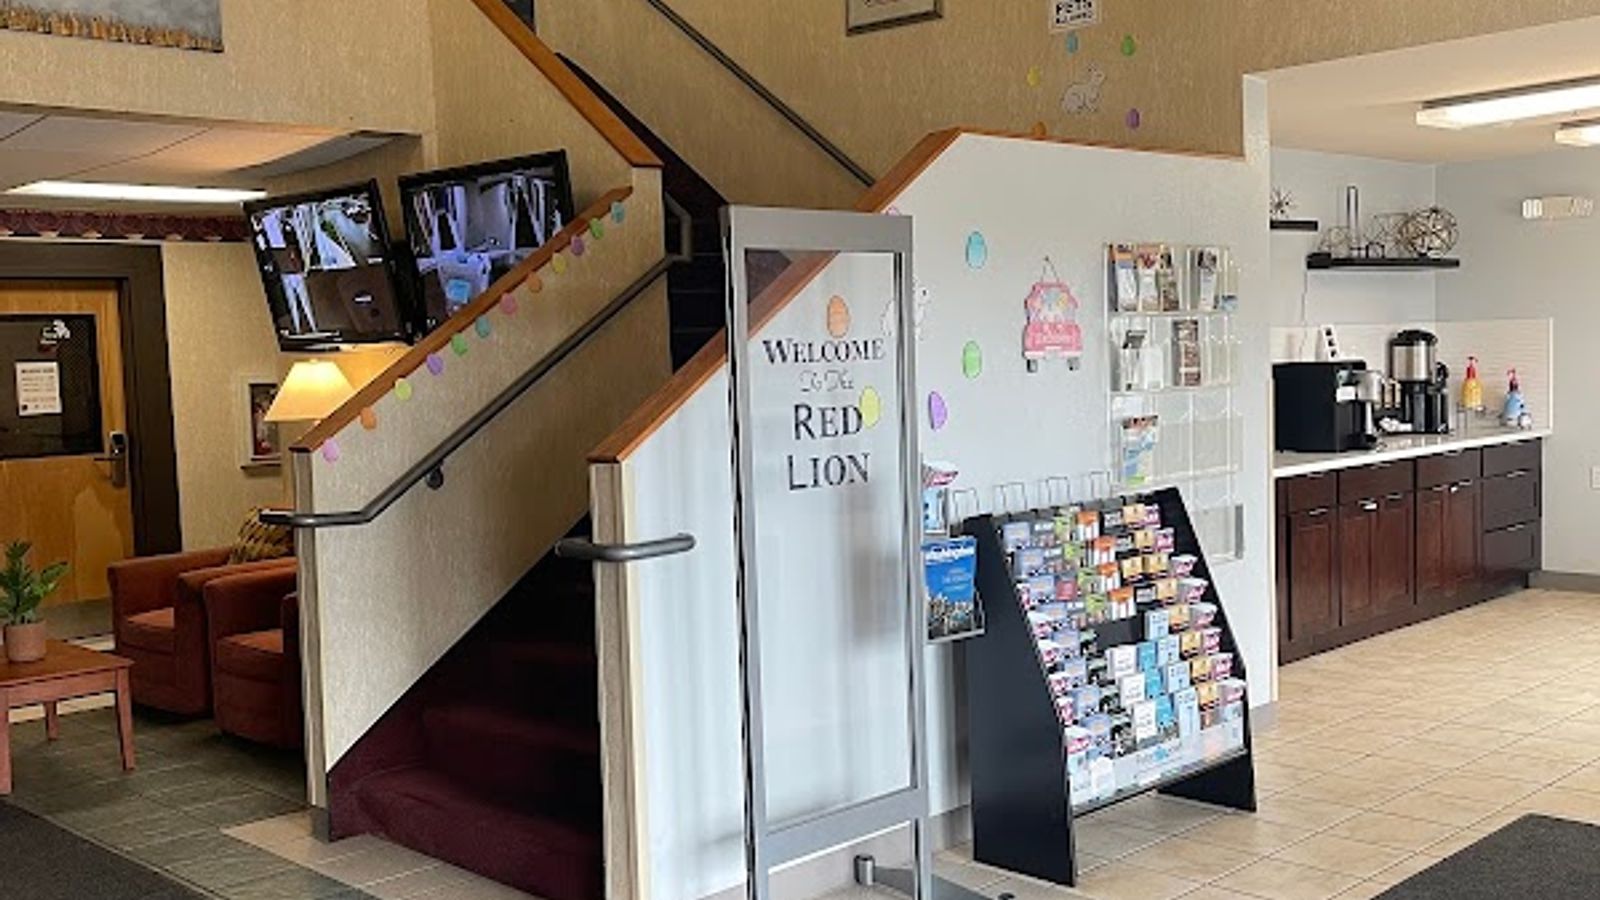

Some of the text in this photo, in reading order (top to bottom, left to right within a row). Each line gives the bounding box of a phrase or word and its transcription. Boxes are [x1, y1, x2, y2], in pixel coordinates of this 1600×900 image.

[762, 338, 886, 365] WELCOME
[793, 402, 863, 440] RED
[787, 453, 871, 490] LION
